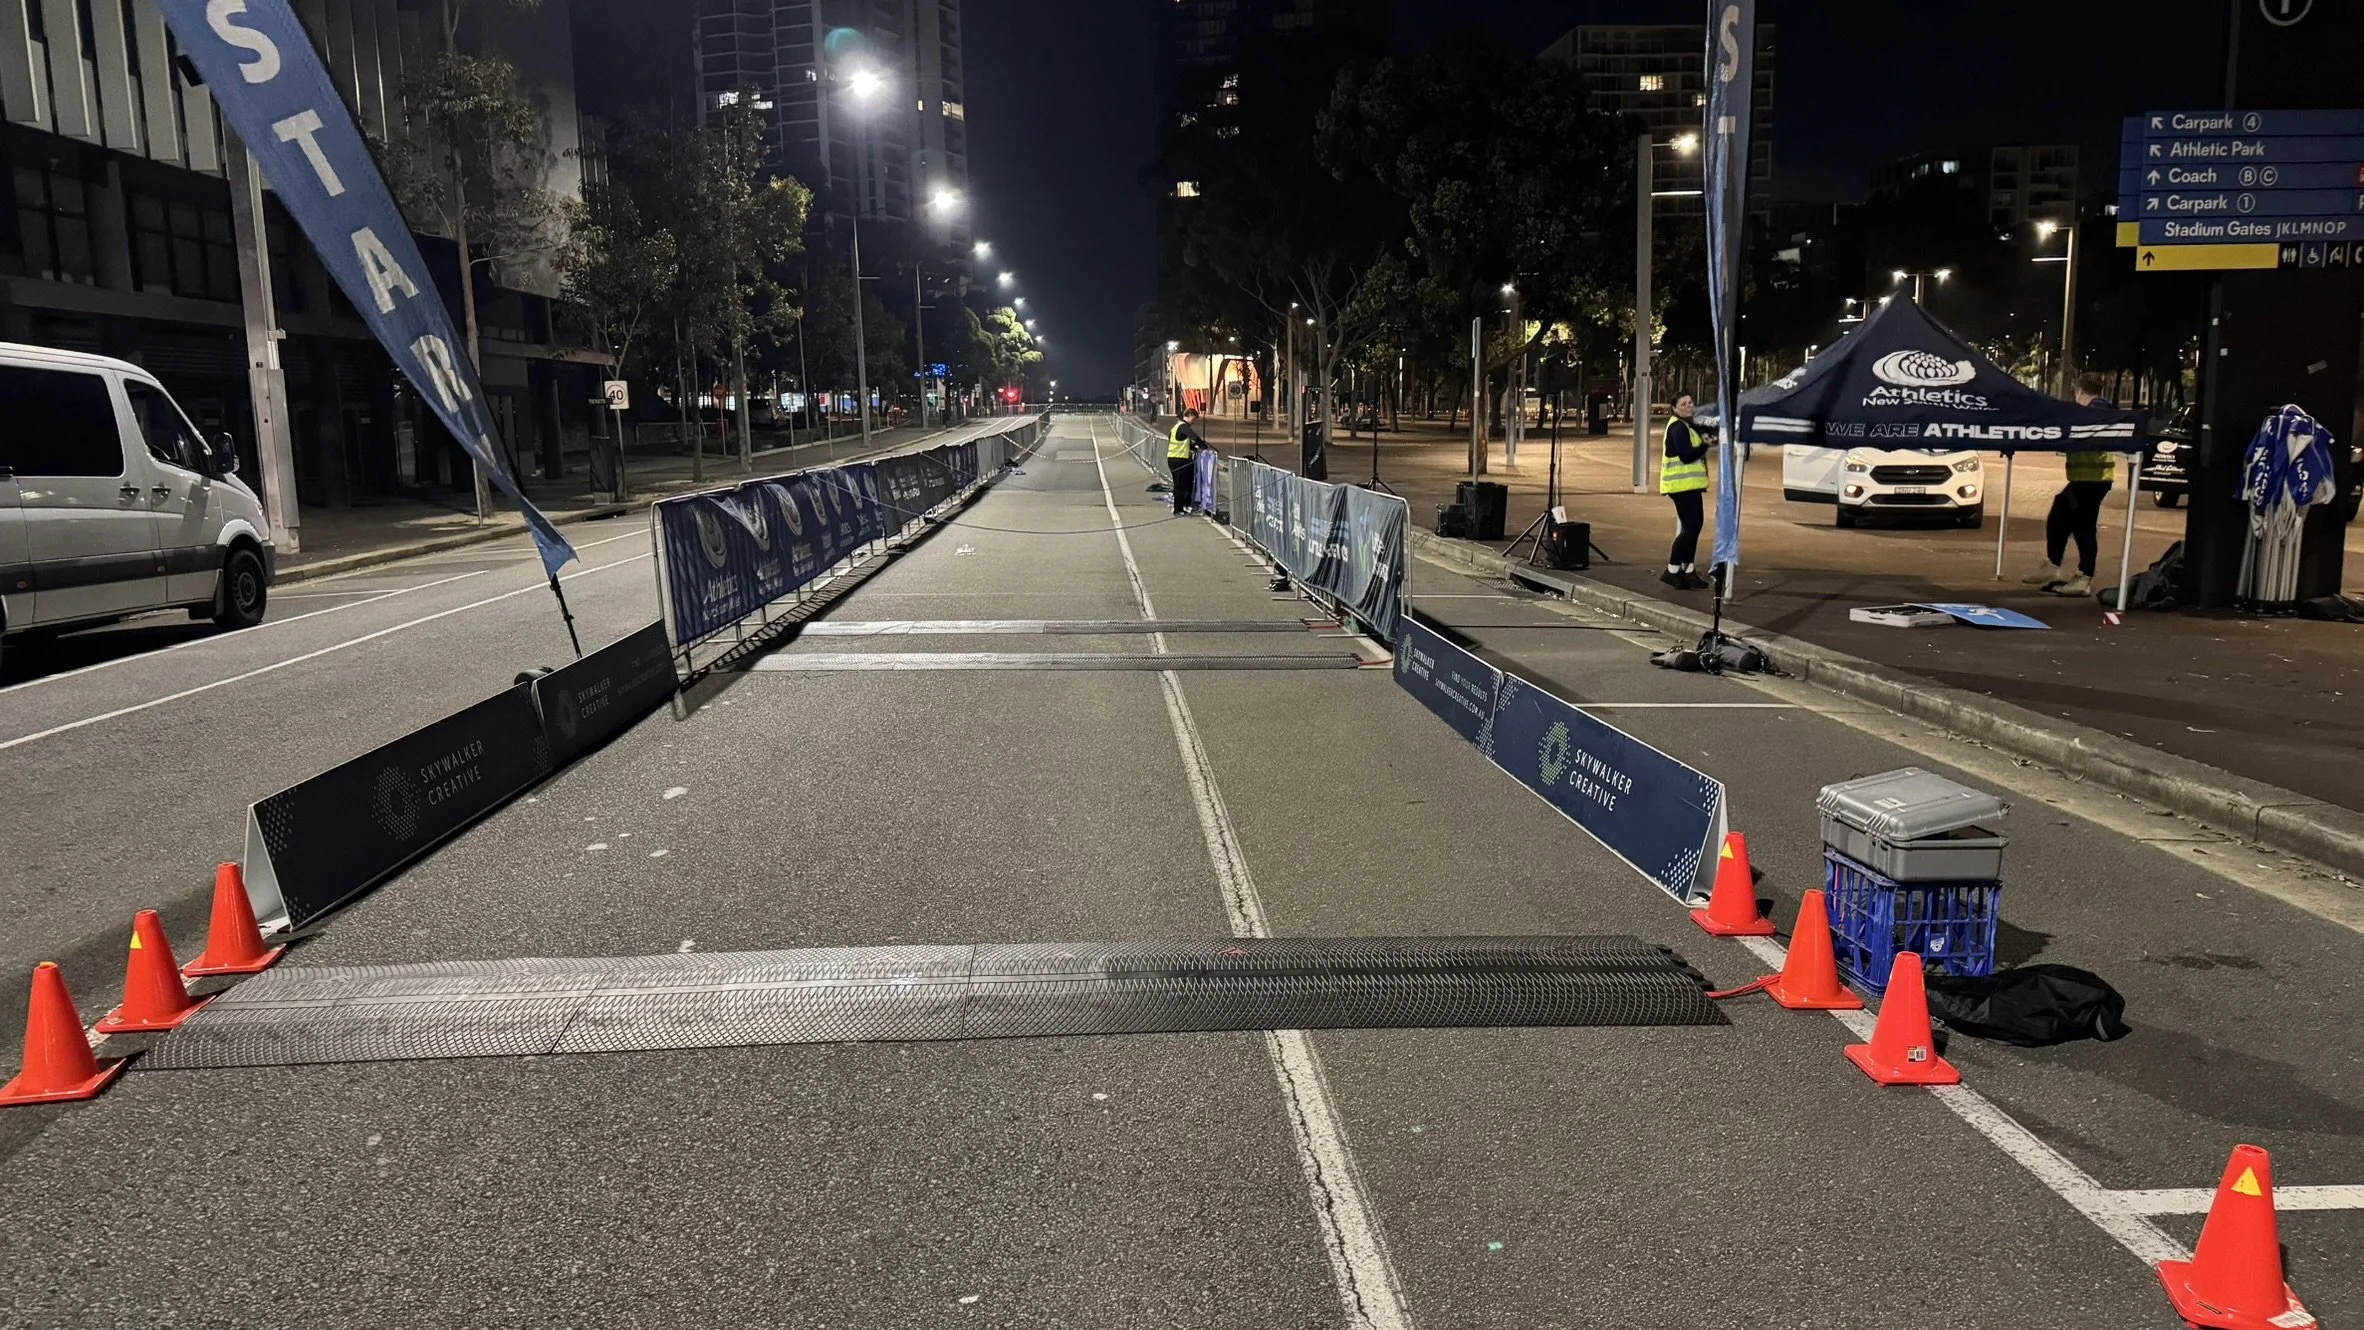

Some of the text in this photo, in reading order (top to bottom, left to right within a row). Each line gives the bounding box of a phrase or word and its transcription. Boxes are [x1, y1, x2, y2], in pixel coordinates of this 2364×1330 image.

[2171, 113, 2234, 134] Carpark
[2169, 141, 2266, 158] Athletic Park
[2168, 167, 2217, 184] Coach
[2167, 194, 2229, 214] Carpark
[2164, 221, 2225, 238] Stadium
[2227, 220, 2272, 236] Gates
[608, 389, 625, 401] 40
[1862, 397, 1901, 407] New
[1868, 385, 1989, 408] Athletics
[1825, 422, 2062, 441] WE ARE ATHLETICS
[1413, 647, 1436, 670] SKYWALKER
[1411, 661, 1430, 681] CREATIVE
[420, 740, 485, 784] SKYWALKER
[1574, 748, 1633, 796] SKYWALKER
[428, 764, 482, 806] CREATIVE
[1569, 770, 1617, 812] CREATIVE
